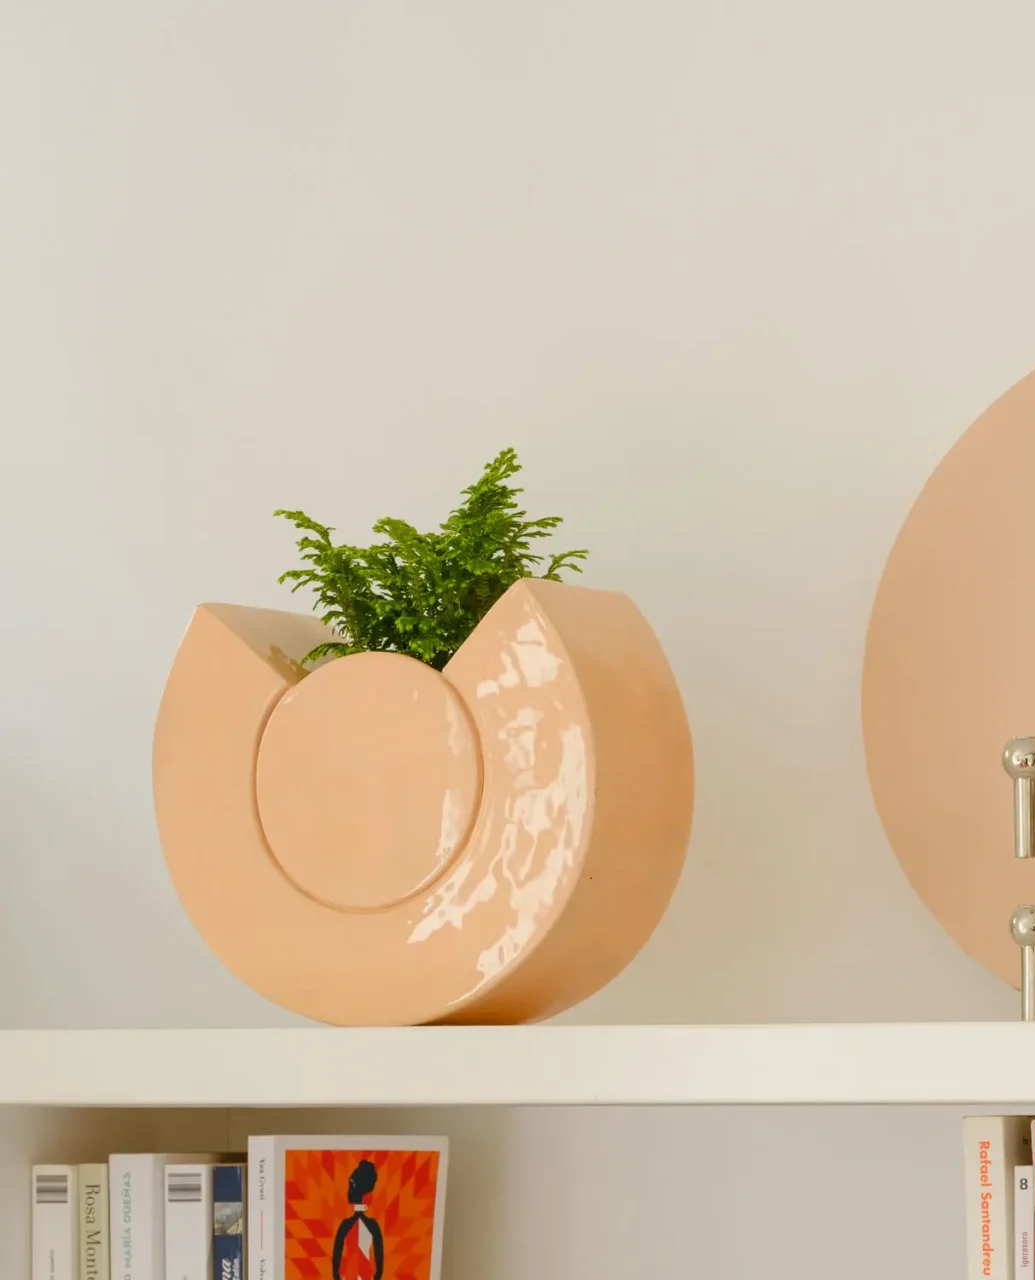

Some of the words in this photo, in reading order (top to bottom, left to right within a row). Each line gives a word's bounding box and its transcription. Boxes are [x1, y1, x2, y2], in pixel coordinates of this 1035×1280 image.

[979, 1141, 993, 1187] Rafael
[1019, 1178, 1029, 1190] 8
[85, 1183, 101, 1224] Rosa
[121, 1172, 131, 1223] DUEÑAS
[258, 1176, 266, 1201] Gyasi
[122, 1227, 132, 1268] MARÍA
[981, 1192, 994, 1276] Santandreu
